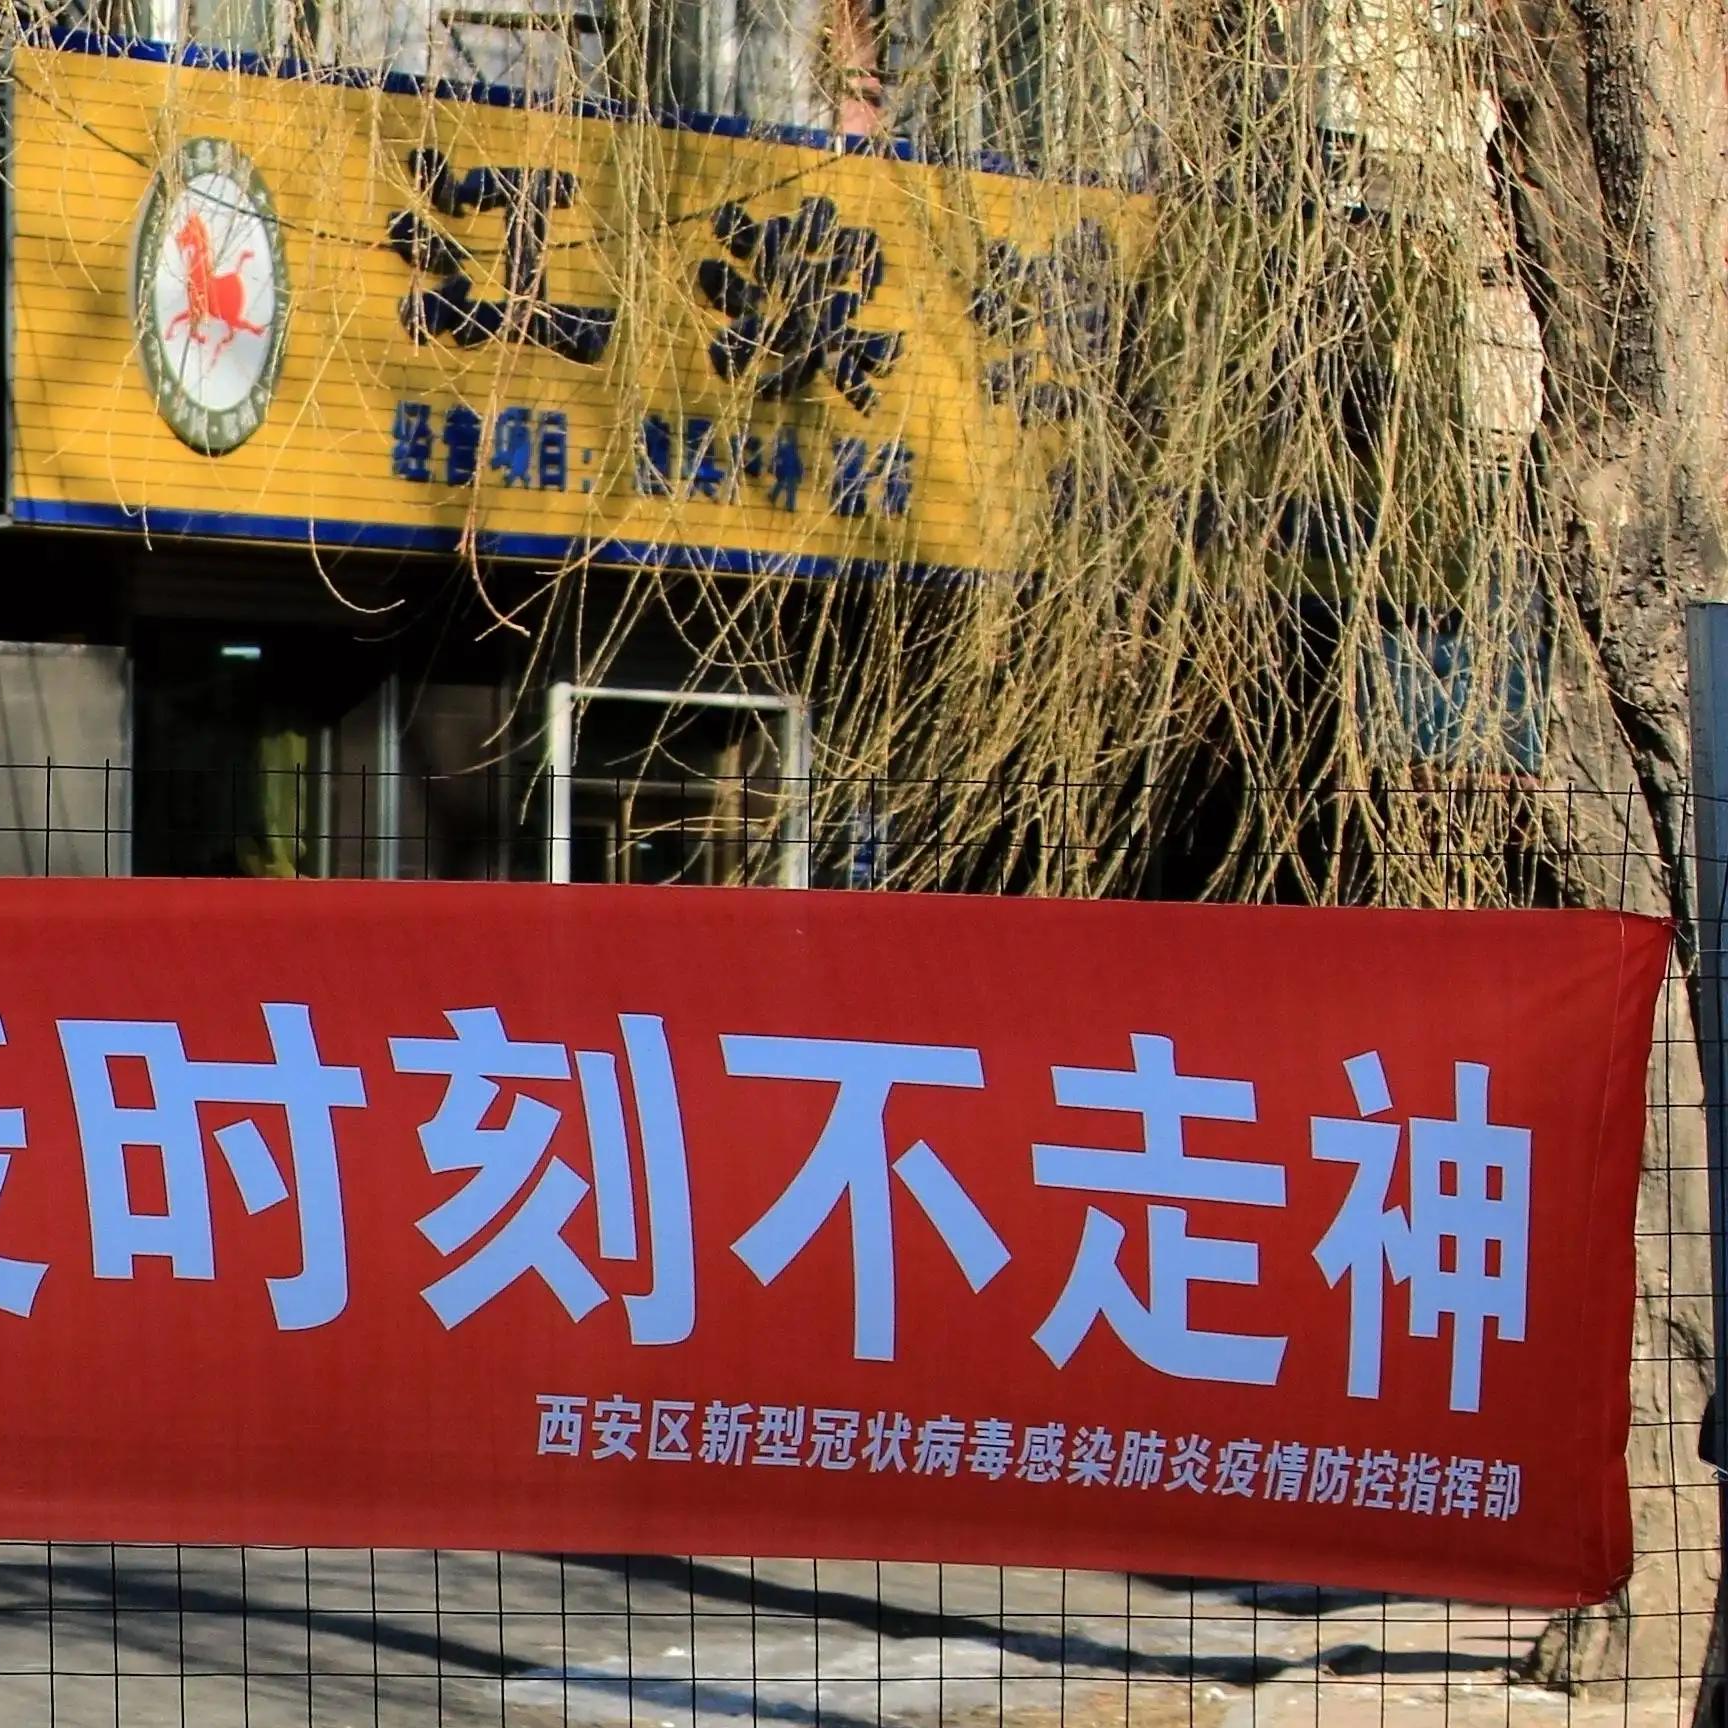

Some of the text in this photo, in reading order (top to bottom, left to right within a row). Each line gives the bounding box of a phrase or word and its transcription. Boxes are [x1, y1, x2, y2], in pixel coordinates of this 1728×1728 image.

[536, 1393, 1521, 1521] 西安区新型冠状病毒感染肺炎疫情防控指挥部
